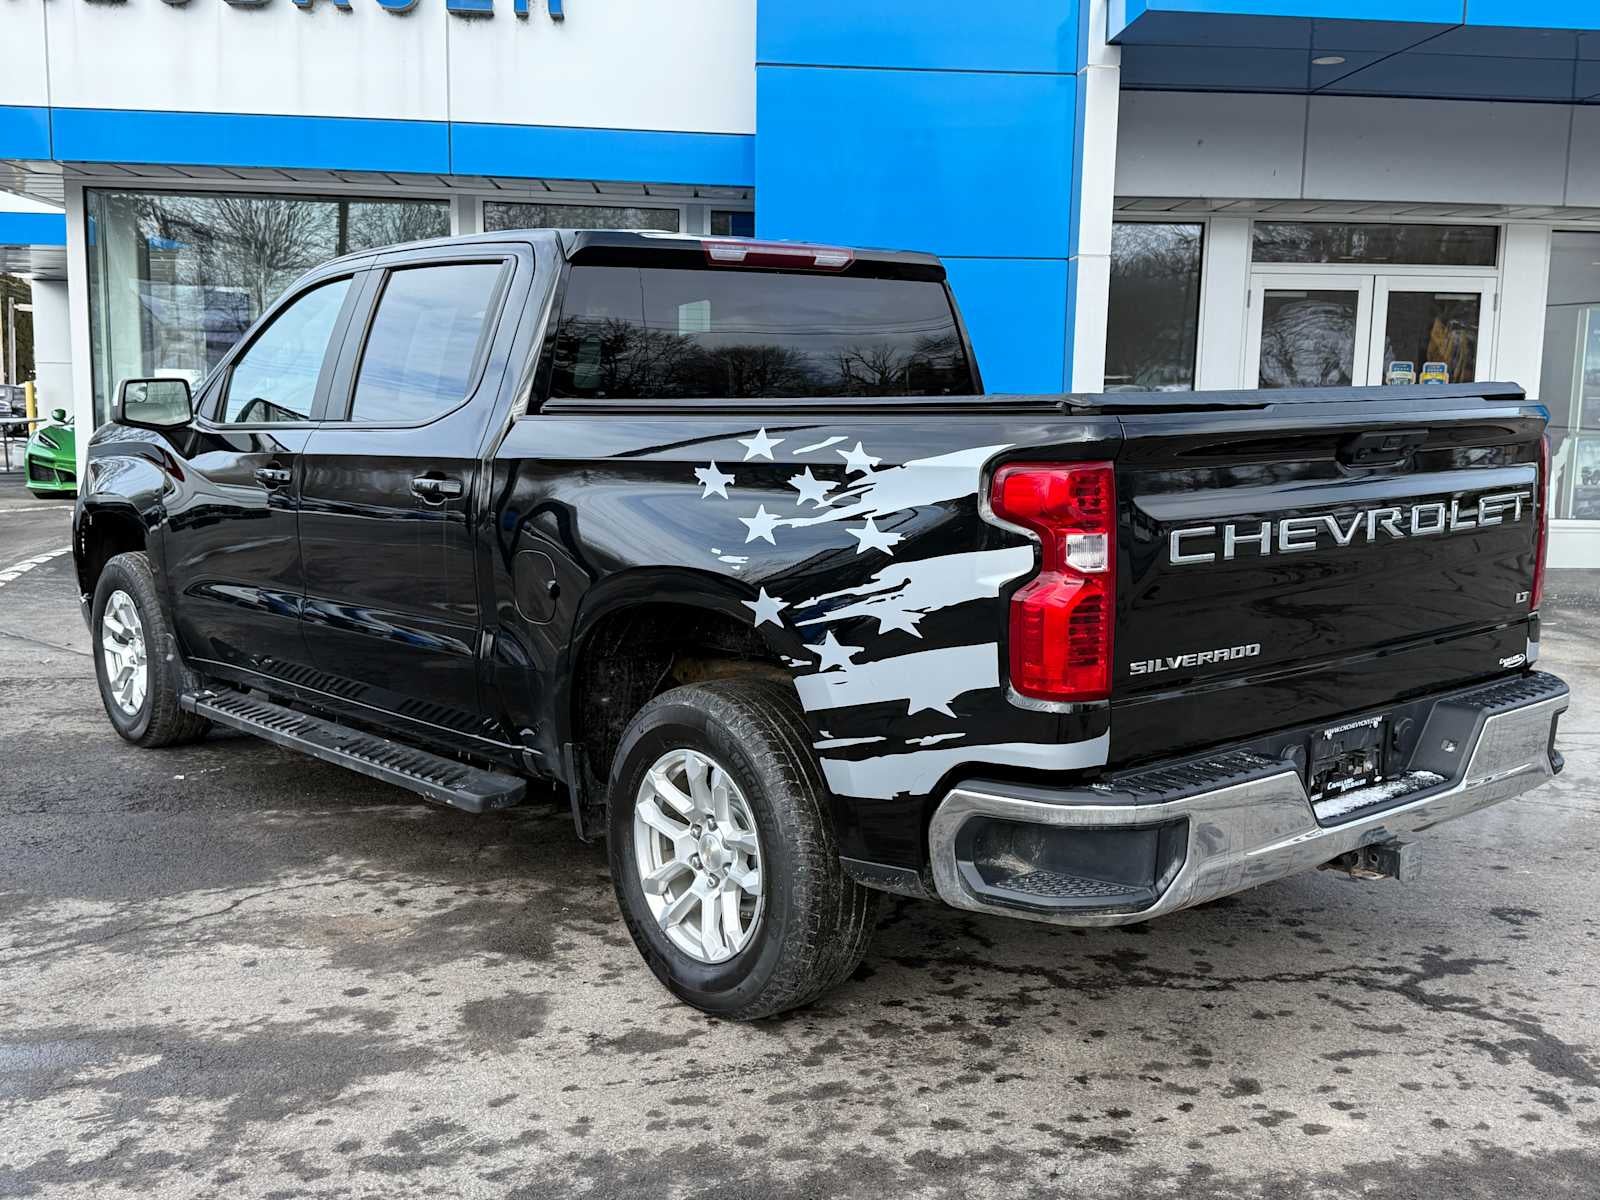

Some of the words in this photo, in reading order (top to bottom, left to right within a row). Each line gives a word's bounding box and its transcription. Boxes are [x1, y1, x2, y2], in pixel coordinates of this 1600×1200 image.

[1169, 490, 1531, 566] CHEVROLET
[1515, 591, 1530, 604] LT
[1128, 642, 1262, 676] SILVERADO
